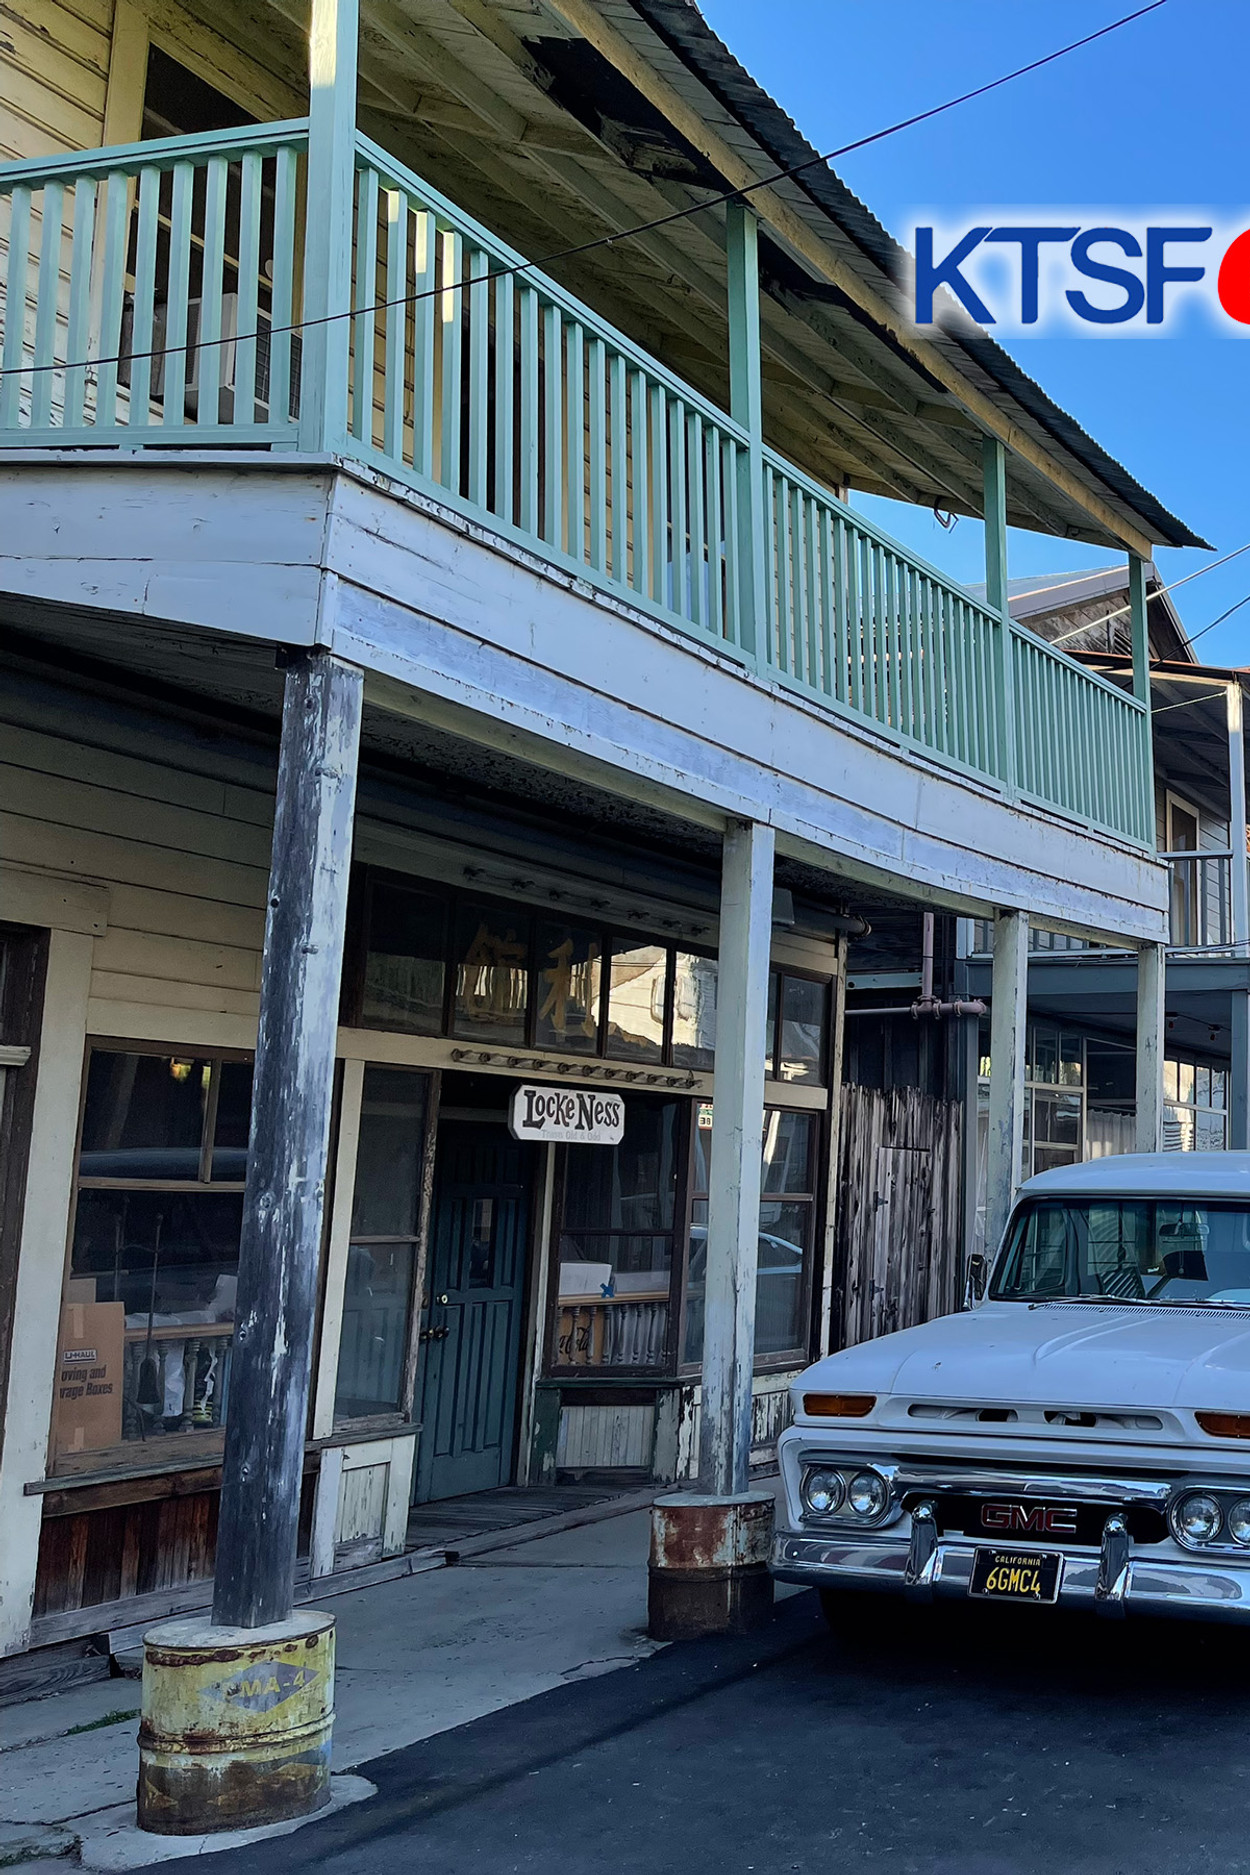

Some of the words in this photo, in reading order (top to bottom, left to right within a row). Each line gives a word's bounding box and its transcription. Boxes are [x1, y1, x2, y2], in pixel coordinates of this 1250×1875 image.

[574, 1093, 621, 1131] Ness
[61, 1367, 88, 1382] oving
[89, 1364, 107, 1379] and
[60, 1386, 84, 1400] rage
[86, 1382, 113, 1396] Boxes
[981, 1503, 1078, 1534] GMC
[994, 1555, 1041, 1567] CALIFORNIA
[986, 1566, 1041, 1594] 6GMC4
